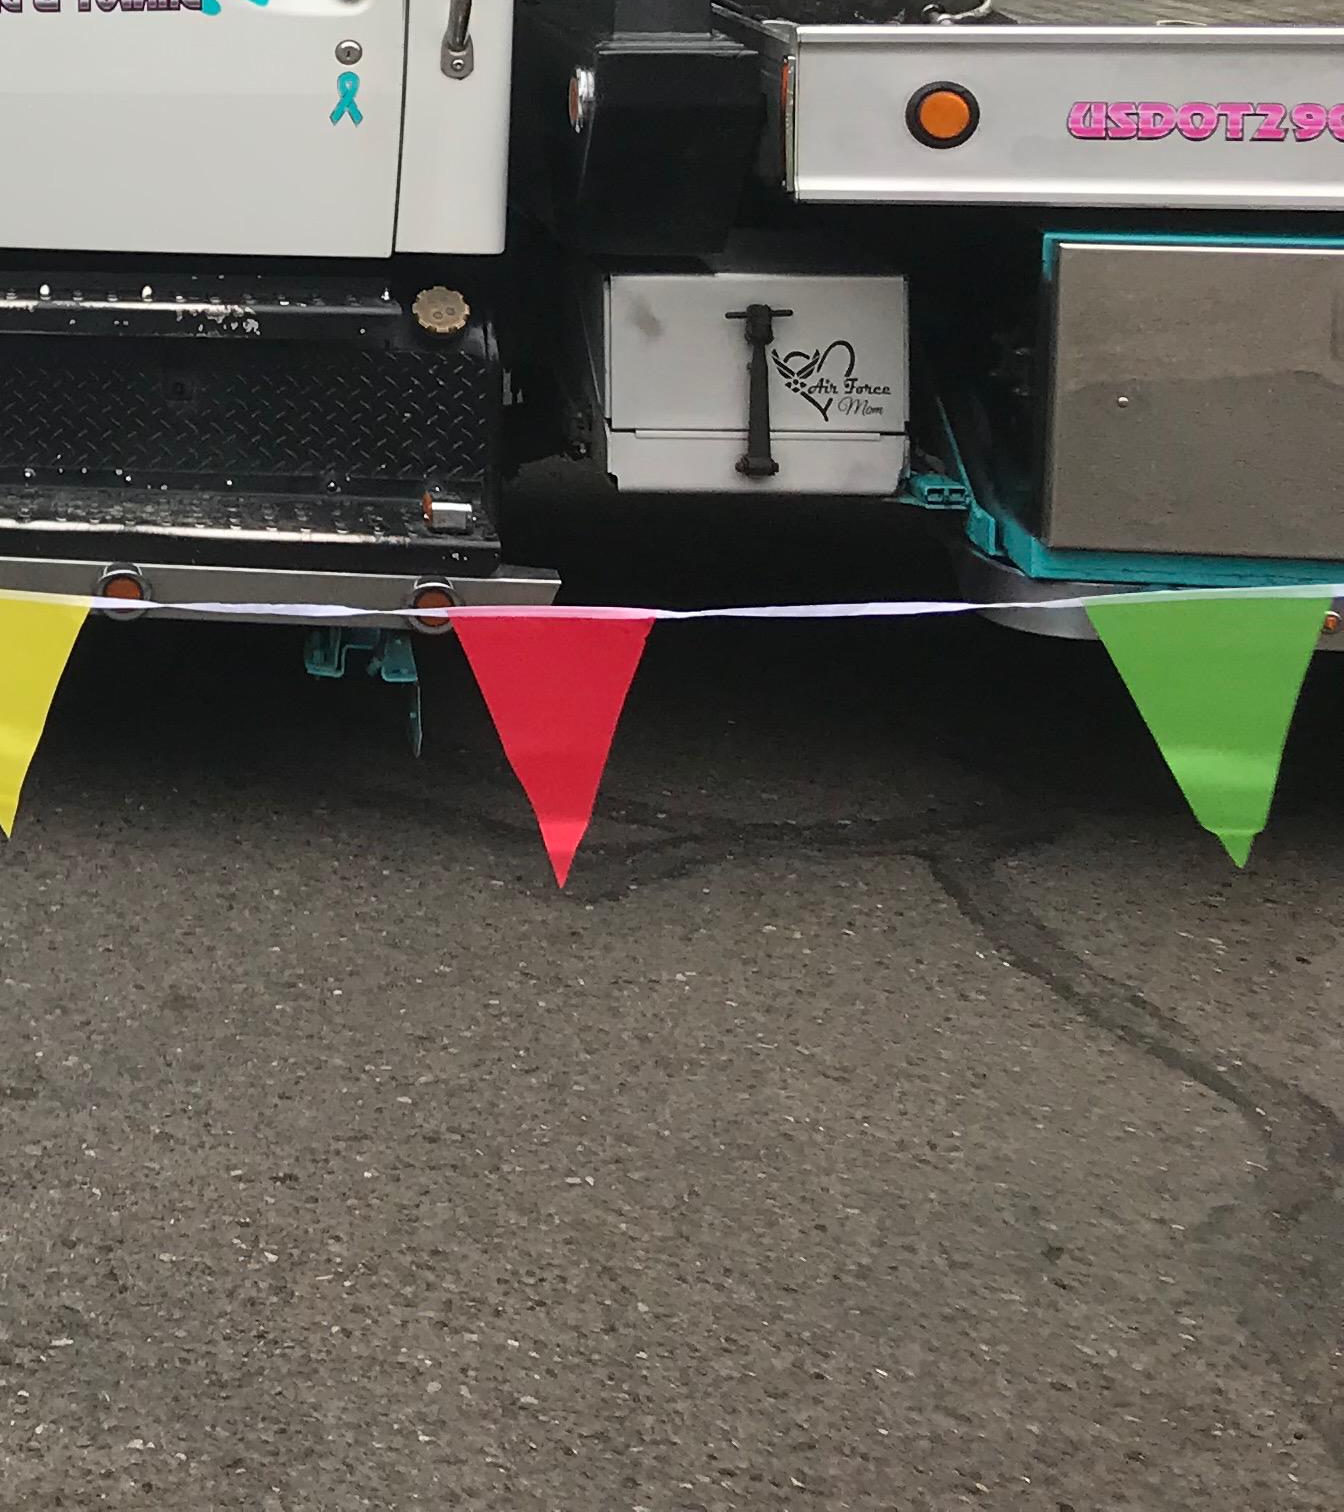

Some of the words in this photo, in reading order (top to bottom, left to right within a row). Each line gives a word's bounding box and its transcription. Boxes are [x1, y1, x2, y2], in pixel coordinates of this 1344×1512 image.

[807, 377, 839, 394] Air
[843, 377, 892, 395] Force
[837, 395, 884, 417] Mom
